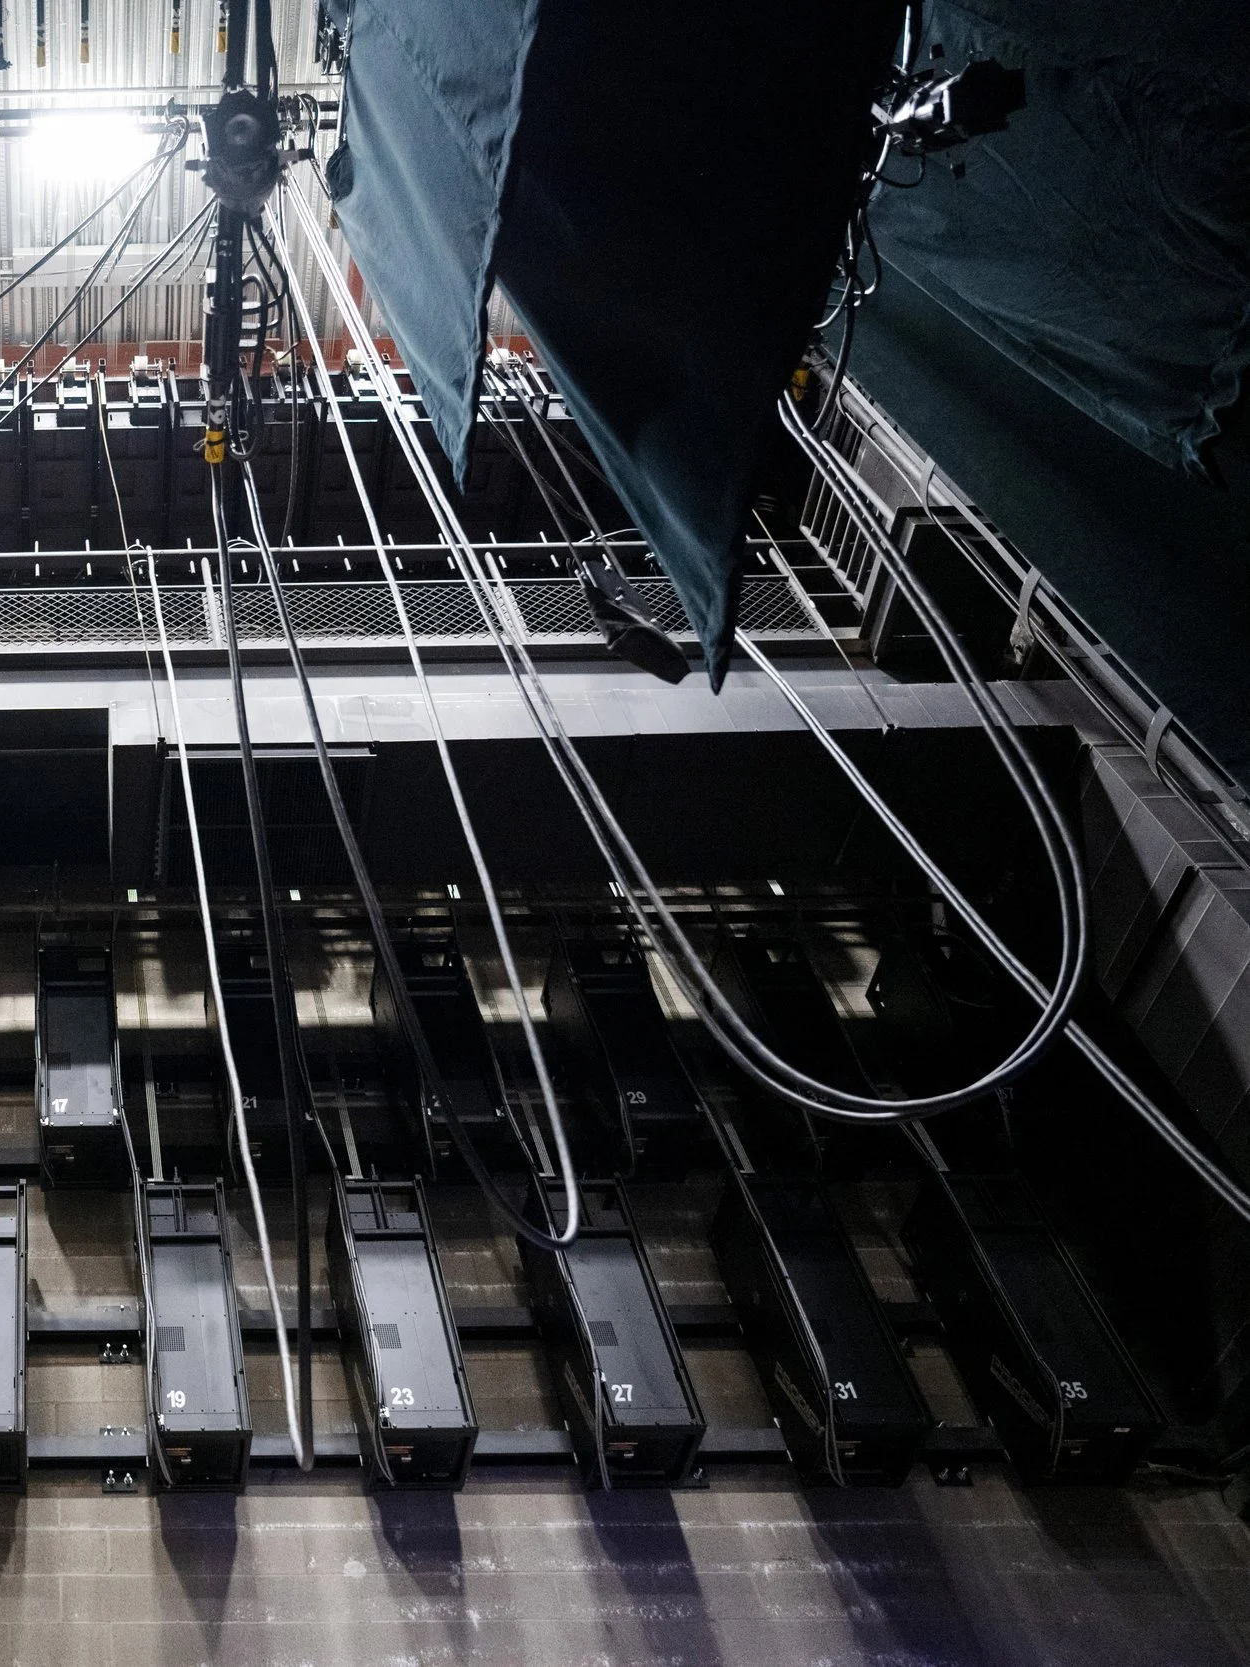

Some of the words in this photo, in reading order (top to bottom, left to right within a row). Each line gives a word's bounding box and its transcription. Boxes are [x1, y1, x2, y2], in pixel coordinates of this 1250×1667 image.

[51, 1098, 69, 1113] 17
[242, 1096, 258, 1109] 21
[626, 1091, 647, 1104] 29
[166, 1390, 186, 1408] 19
[390, 1387, 414, 1406] 23
[611, 1384, 633, 1402] 27
[834, 1381, 858, 1400] 31
[1060, 1381, 1088, 1399] 35
